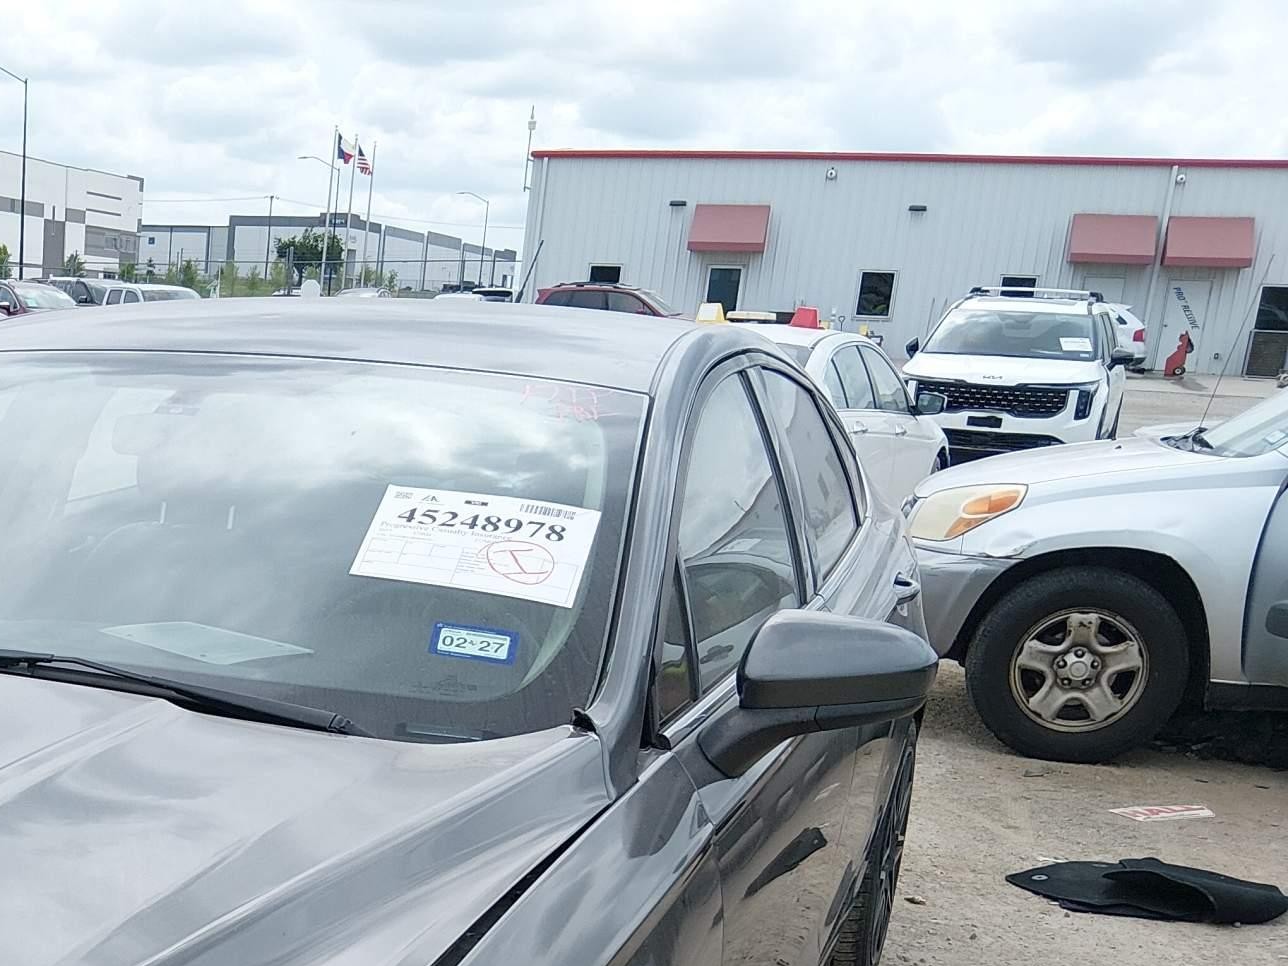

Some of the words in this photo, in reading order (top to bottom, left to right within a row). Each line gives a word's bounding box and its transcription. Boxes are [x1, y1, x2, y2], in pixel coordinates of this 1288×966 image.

[1173, 287, 1200, 330] PRORESSIVE
[397, 507, 567, 542] 45248978
[442, 636, 467, 648] 02
[478, 640, 505, 653] 27
